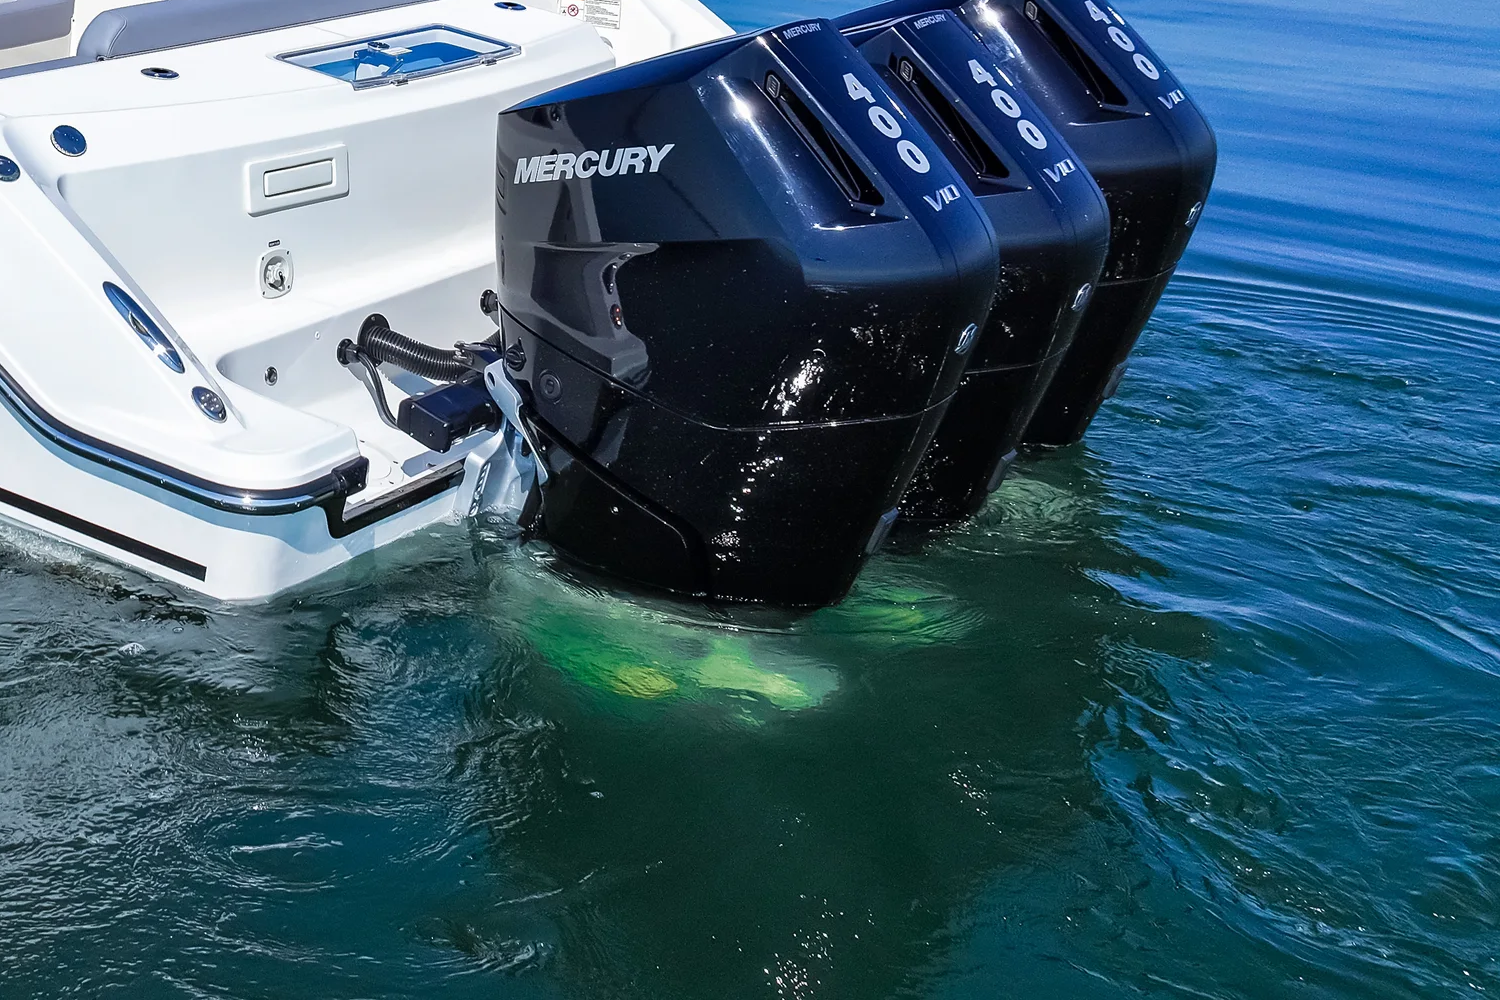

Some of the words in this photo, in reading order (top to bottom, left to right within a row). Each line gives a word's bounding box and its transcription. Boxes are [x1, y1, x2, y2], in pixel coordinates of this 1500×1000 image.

[782, 22, 822, 40] MERCURY
[913, 13, 947, 30] MERCURY
[1084, 0, 1160, 80] 400
[842, 72, 931, 174] 400
[968, 59, 1048, 150] 400
[513, 143, 676, 185] MERCURY
[922, 183, 961, 212] V10
